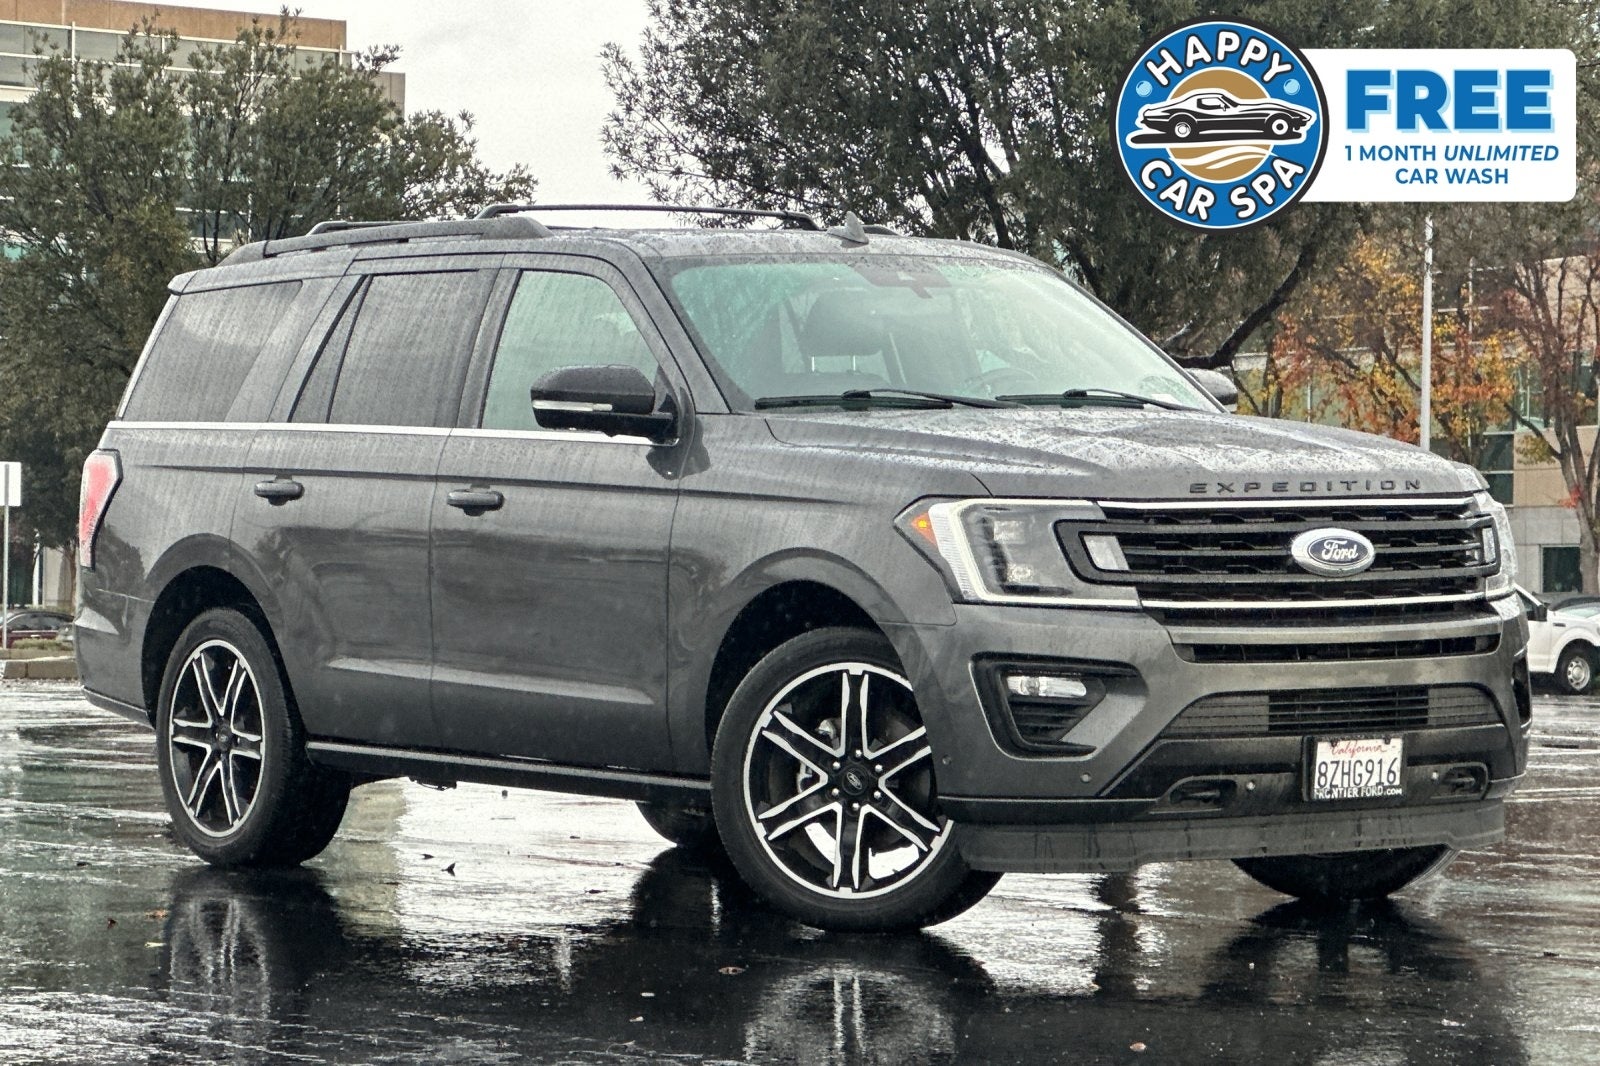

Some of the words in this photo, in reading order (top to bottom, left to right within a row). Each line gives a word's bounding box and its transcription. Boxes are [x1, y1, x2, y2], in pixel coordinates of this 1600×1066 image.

[1189, 478, 1422, 494] EXPEDITION
[1321, 539, 1359, 560] Ford
[1331, 743, 1387, 758] California
[1317, 757, 1398, 788] 8ZHG916
